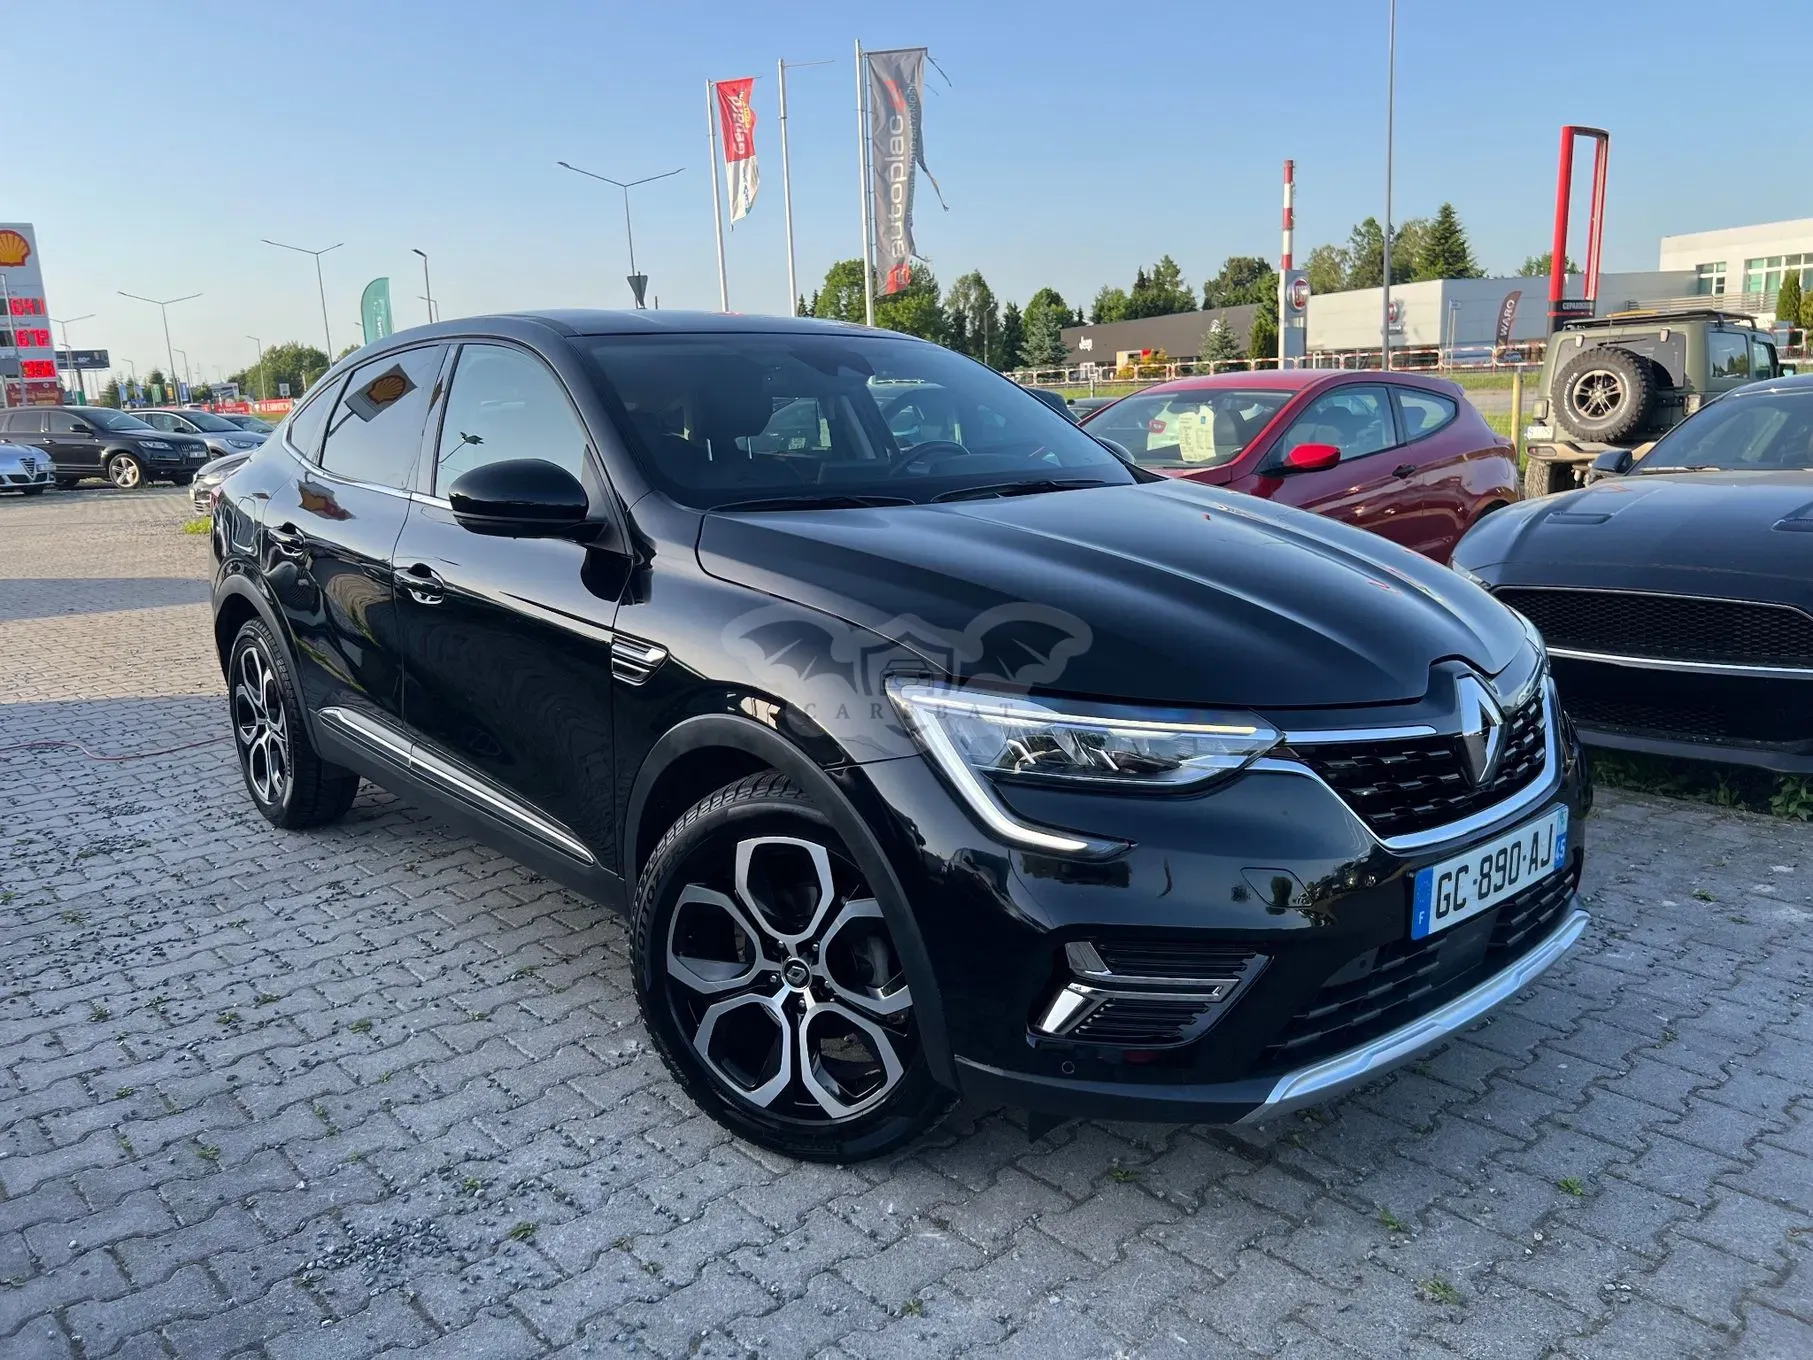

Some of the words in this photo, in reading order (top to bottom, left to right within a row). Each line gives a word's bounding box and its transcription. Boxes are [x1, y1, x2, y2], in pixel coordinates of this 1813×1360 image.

[885, 114, 908, 259] autoplac
[1418, 910, 1425, 925] F
[1436, 824, 1553, 919] GC-890-AJ
